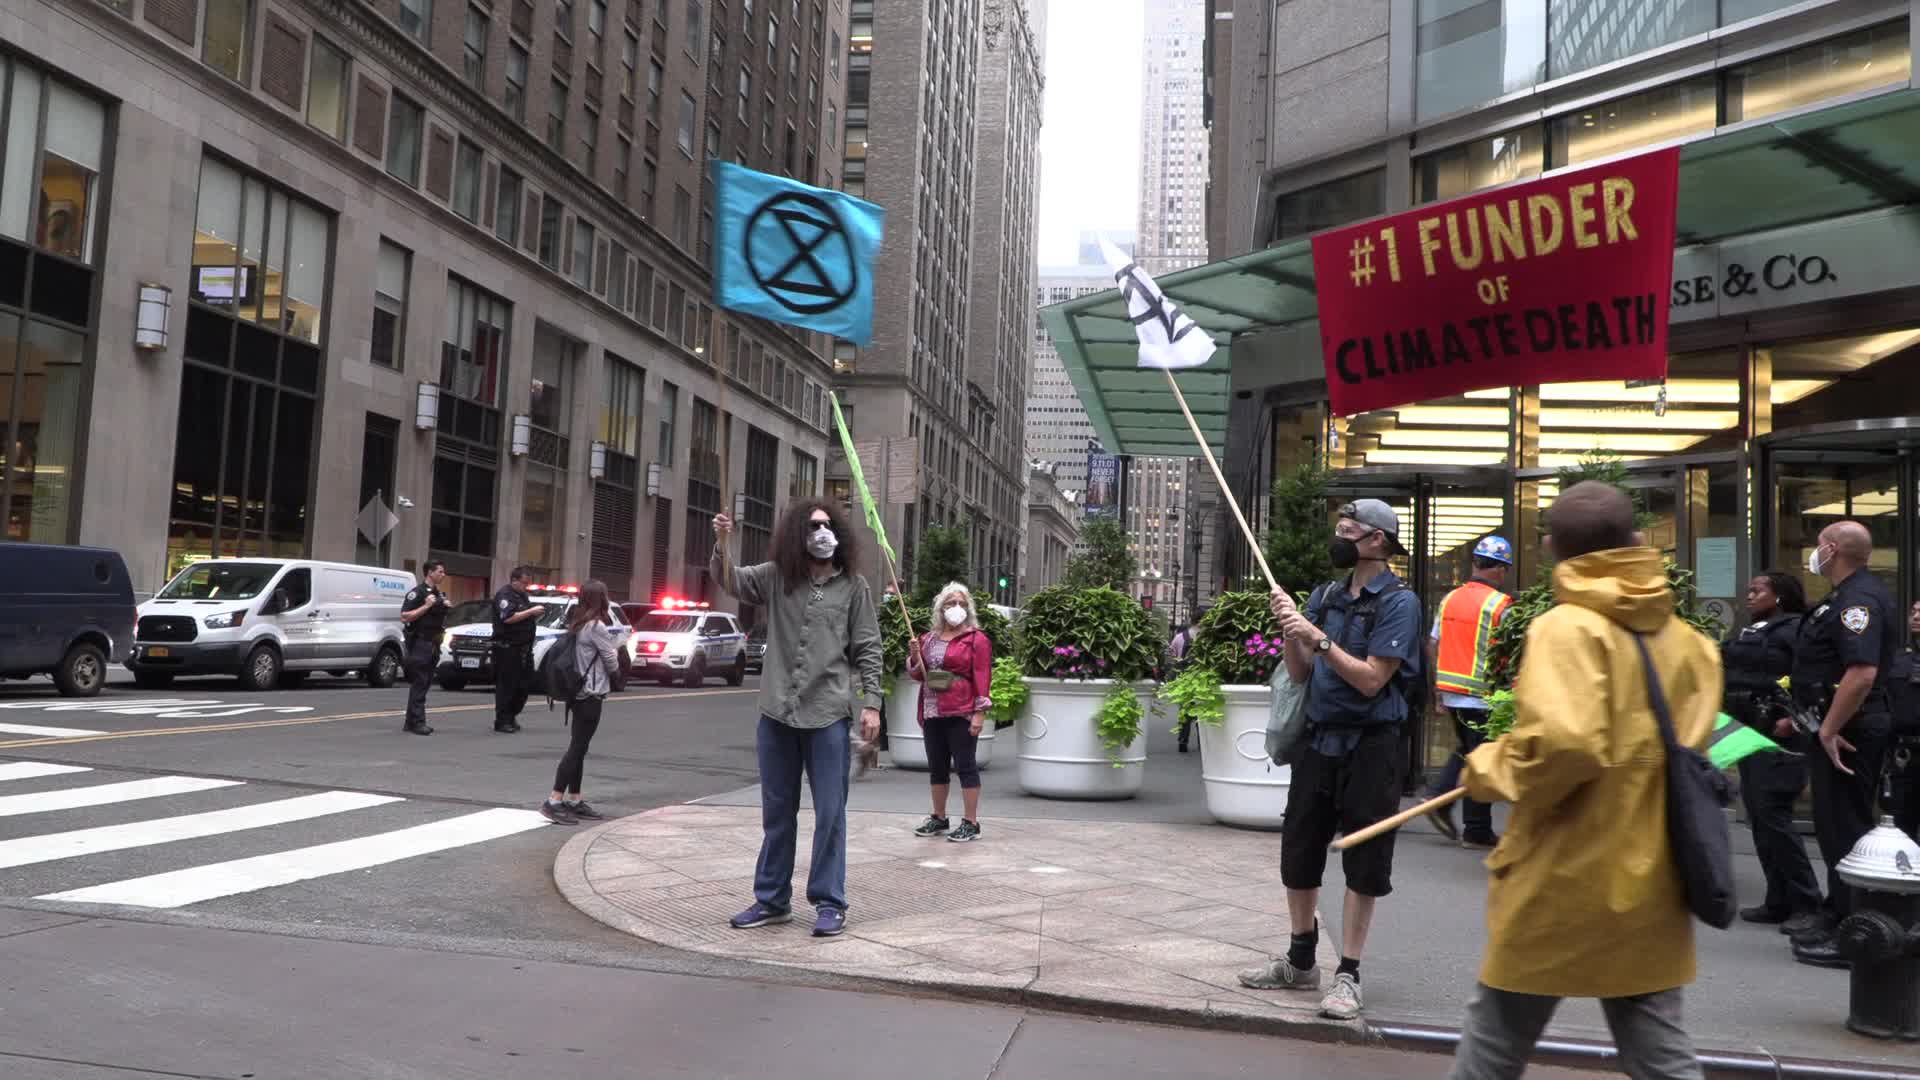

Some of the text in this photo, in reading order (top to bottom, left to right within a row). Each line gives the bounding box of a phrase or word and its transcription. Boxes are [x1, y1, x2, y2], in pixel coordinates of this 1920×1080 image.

[1349, 176, 1639, 287] #1 FUNDER
[1476, 275, 1510, 305] OF
[1669, 274, 1716, 308] SE
[1722, 263, 1758, 298] &
[1335, 292, 1657, 384] CLIMATE DEATH
[1091, 468, 1115, 476] NEVER
